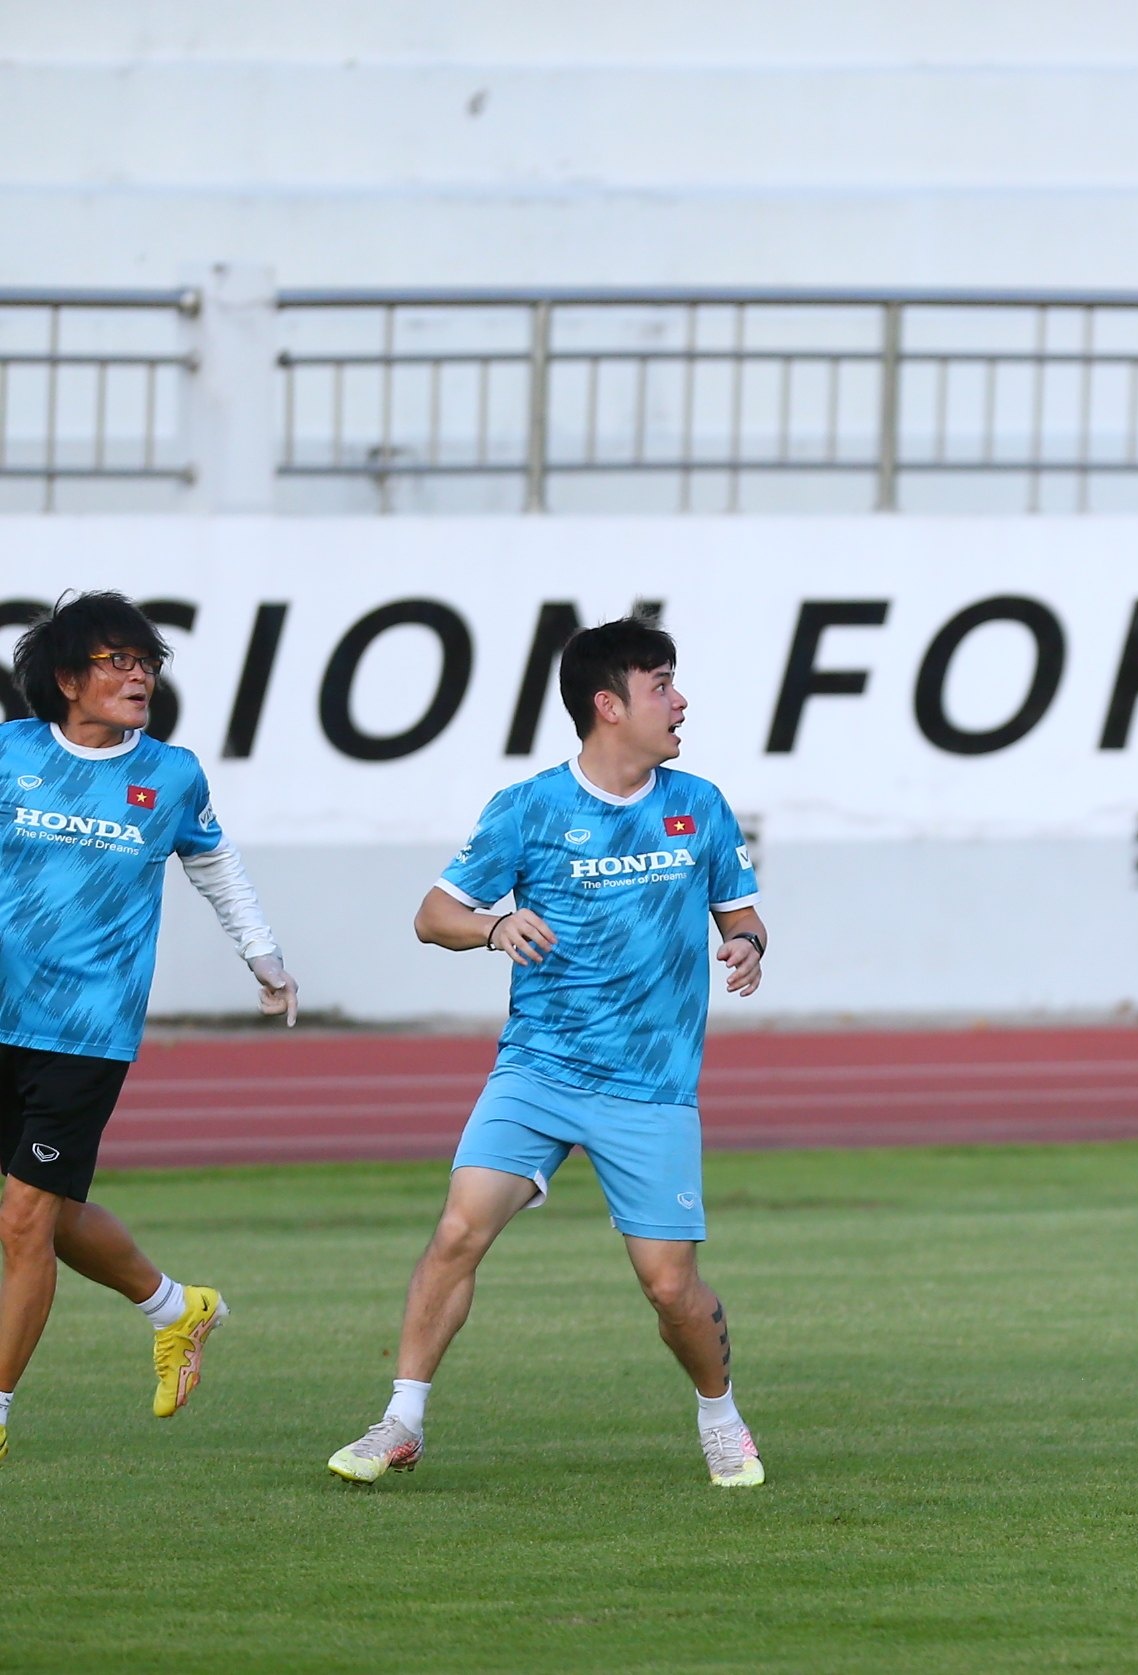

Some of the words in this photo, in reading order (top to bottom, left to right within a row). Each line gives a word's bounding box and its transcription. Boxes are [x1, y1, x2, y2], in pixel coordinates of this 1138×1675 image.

[14, 807, 145, 844] HONDA
[15, 827, 37, 839] The
[38, 831, 78, 845] Power
[79, 836, 93, 848] of
[95, 839, 140, 856] Dreams
[570, 848, 695, 878] HONDA
[582, 880, 601, 890] The
[603, 877, 636, 888] Power
[638, 873, 650, 884] of
[651, 871, 688, 884] Dreams
